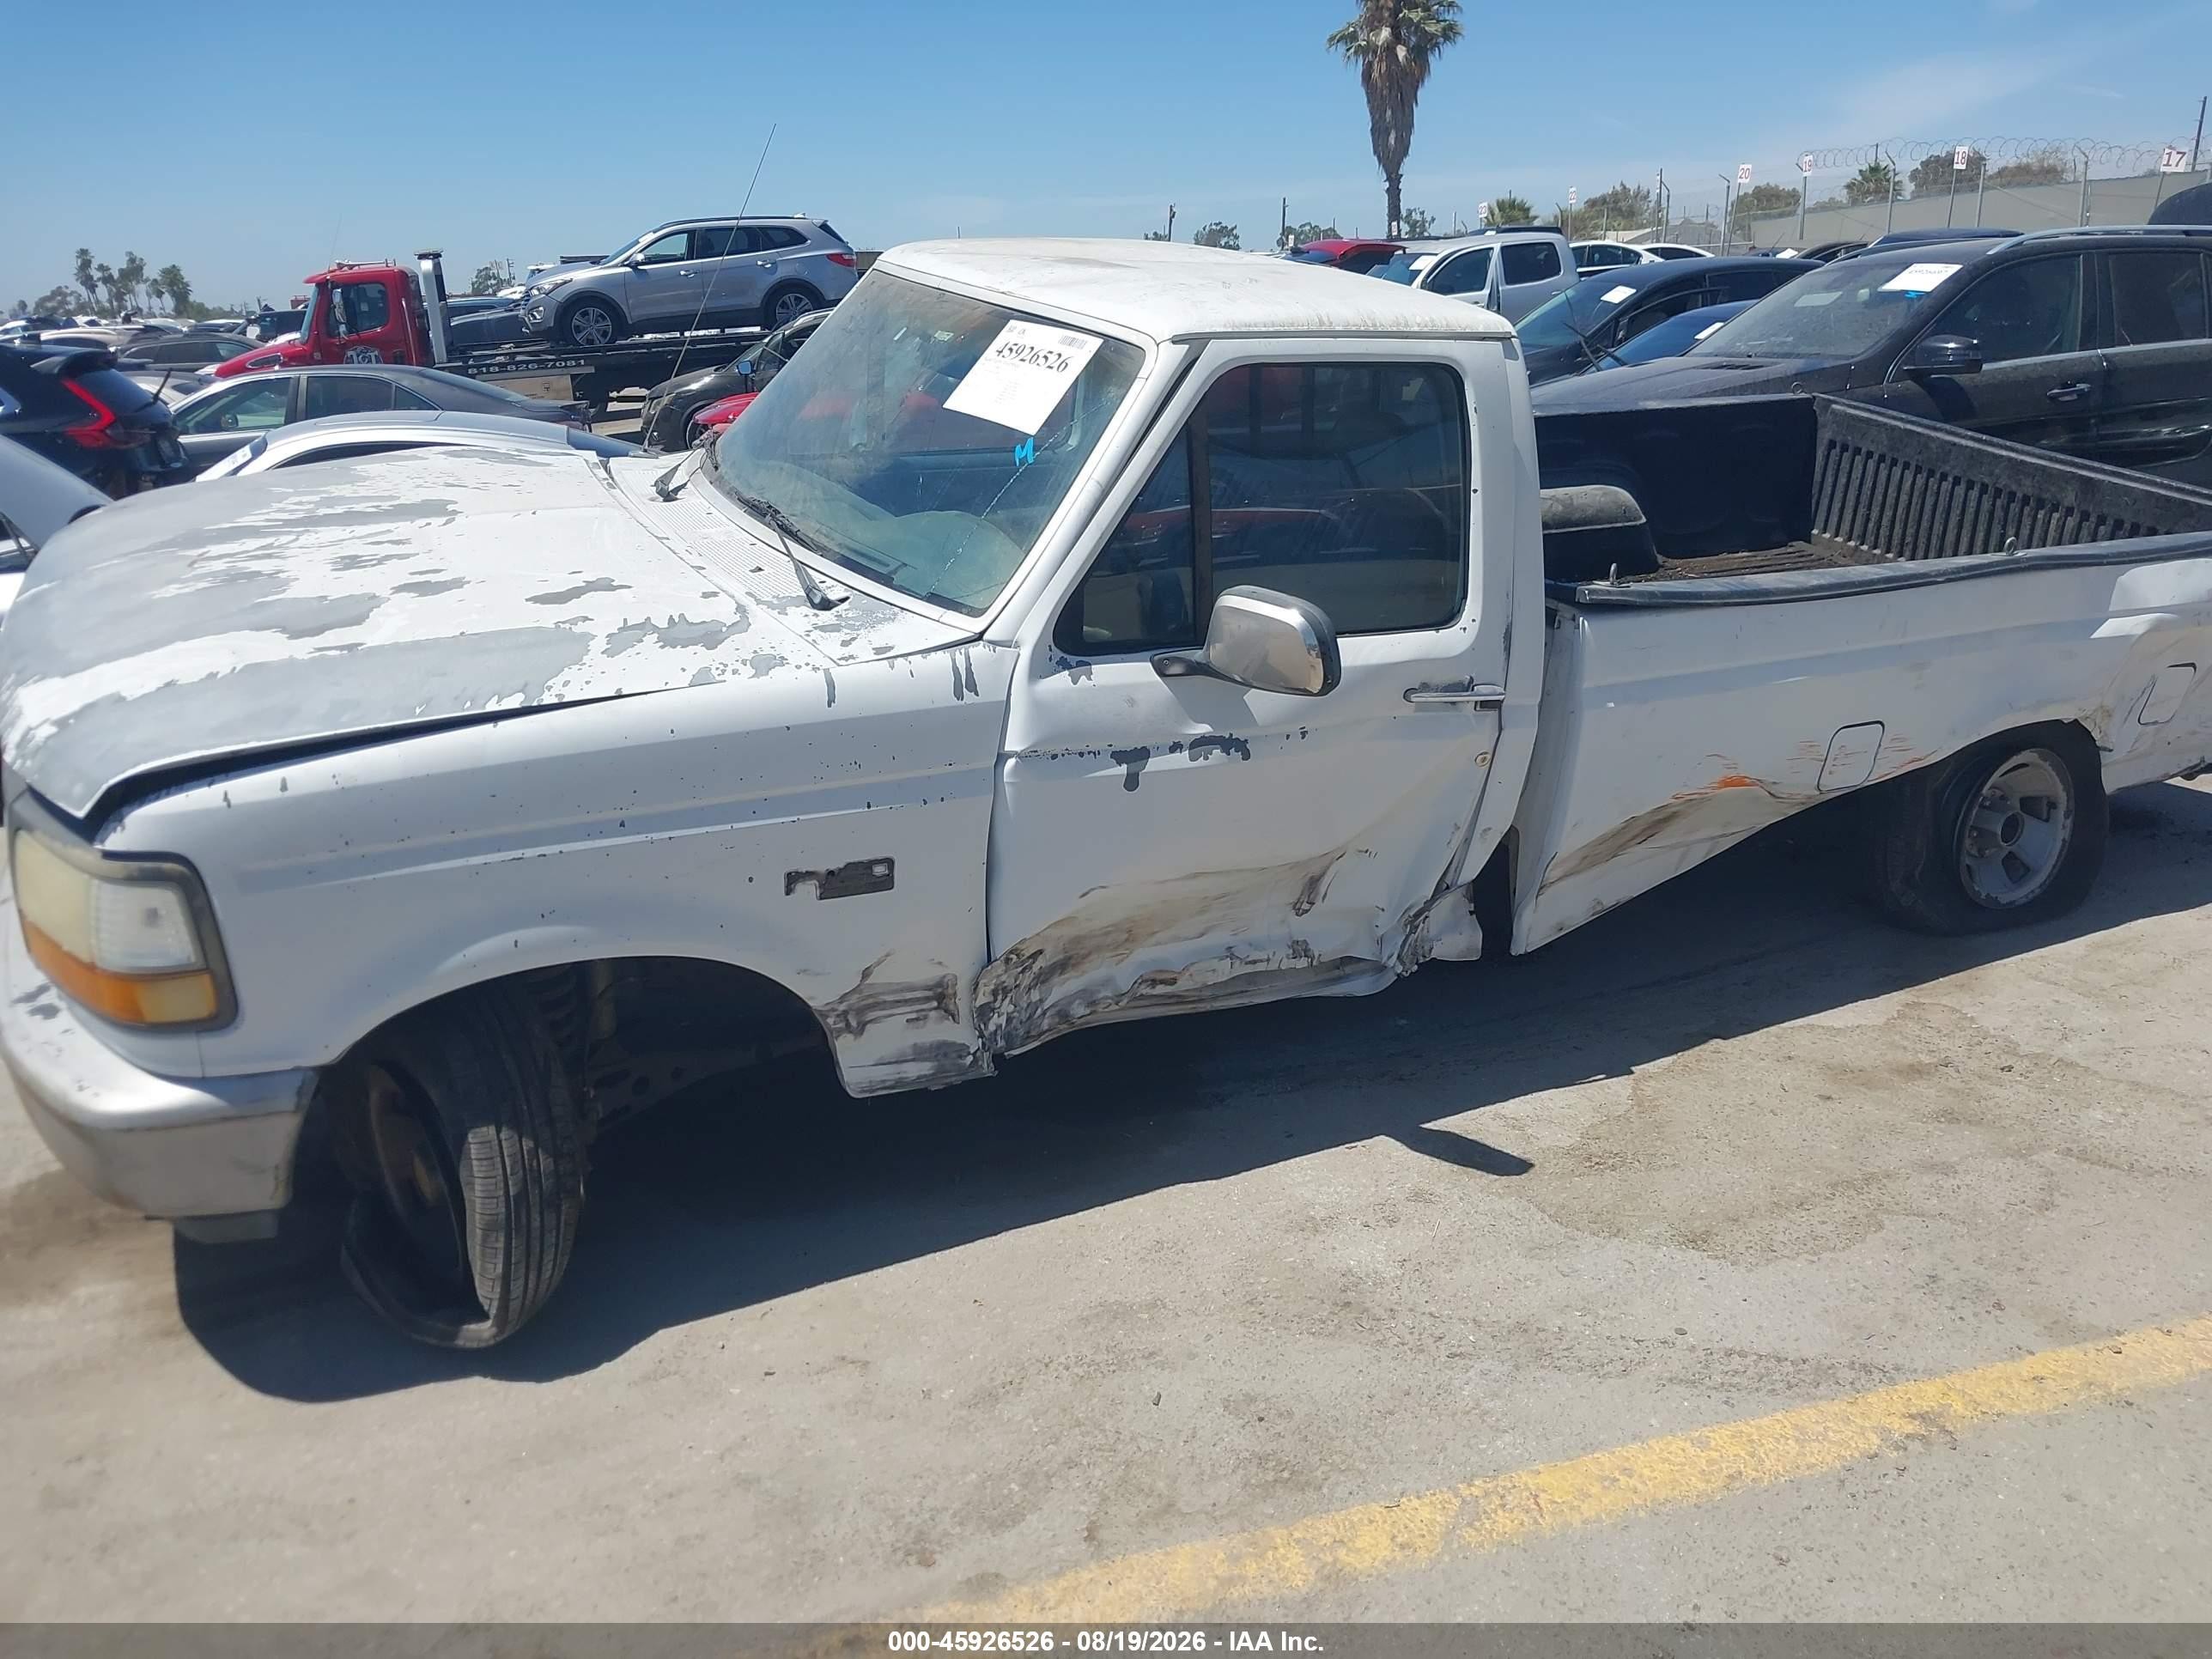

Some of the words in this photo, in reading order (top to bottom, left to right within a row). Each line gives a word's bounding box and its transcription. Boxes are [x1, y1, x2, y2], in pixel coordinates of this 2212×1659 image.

[1954, 150, 1966, 166] 18
[2162, 150, 2187, 167] 17
[1739, 167, 1751, 179] 20
[1803, 159, 1812, 173] 19
[995, 341, 1075, 374] 45926526
[467, 359, 585, 374] 818-826-7081
